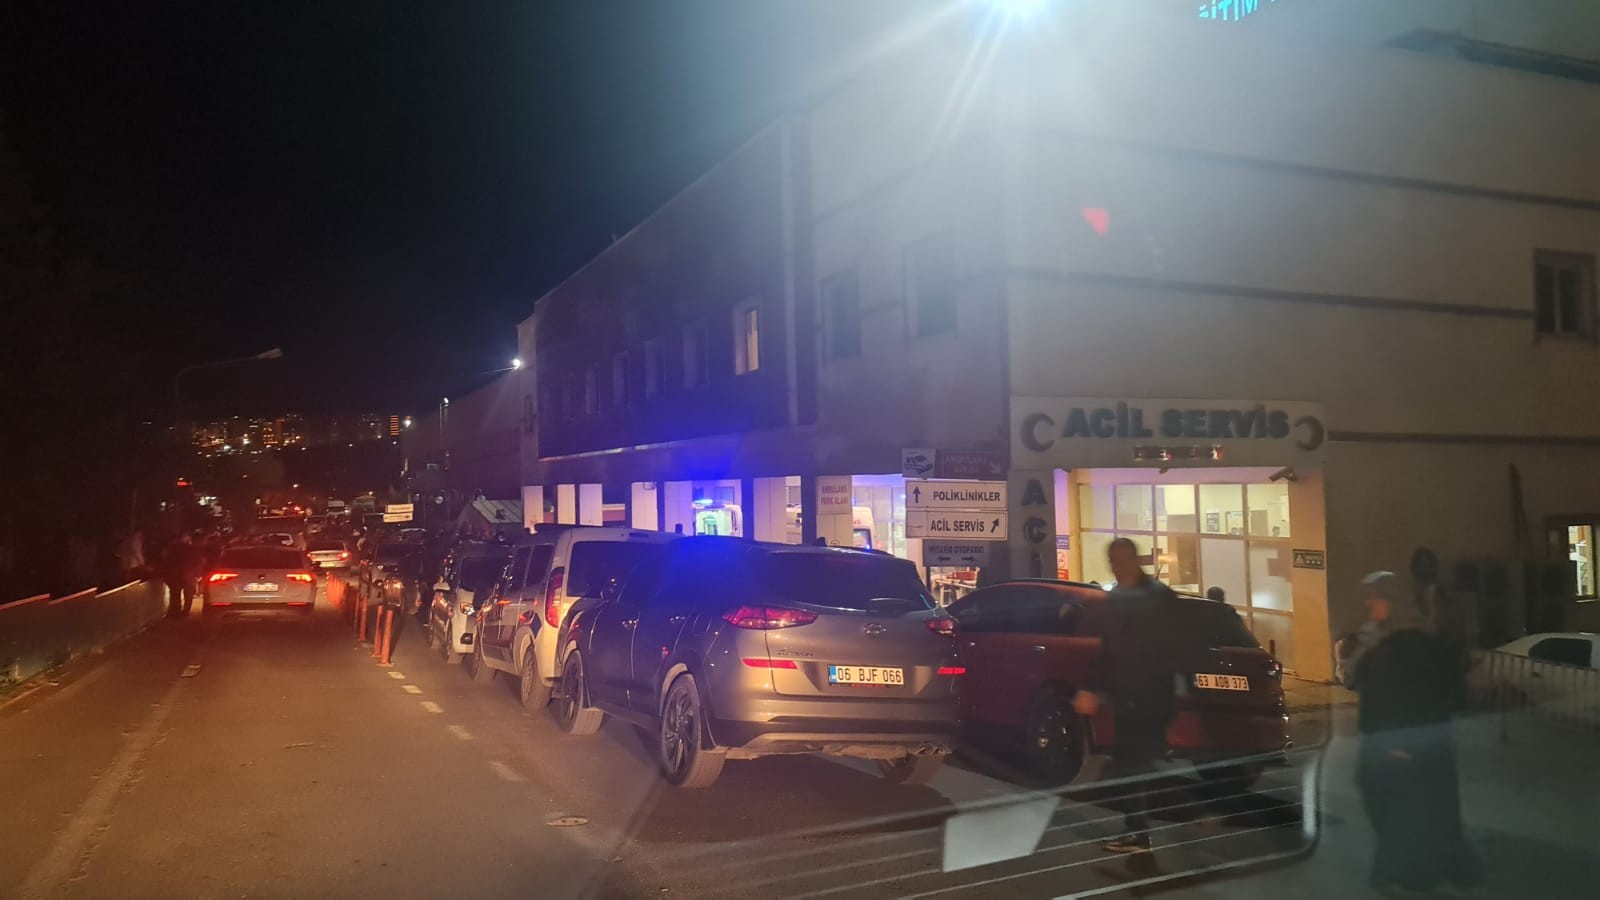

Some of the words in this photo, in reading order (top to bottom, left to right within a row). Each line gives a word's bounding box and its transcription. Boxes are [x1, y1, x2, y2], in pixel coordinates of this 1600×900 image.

[1061, 401, 1153, 438] ACİL
[1160, 404, 1290, 438] SERVİS
[932, 489, 1001, 502] POLİKLİNİKLER
[930, 518, 951, 531] ACİL
[953, 518, 985, 532] SERVİS
[837, 667, 852, 680] 06
[858, 668, 877, 681] BJF
[882, 669, 902, 682] 066
[1198, 675, 1209, 687] 63
[1232, 677, 1248, 689] 373
